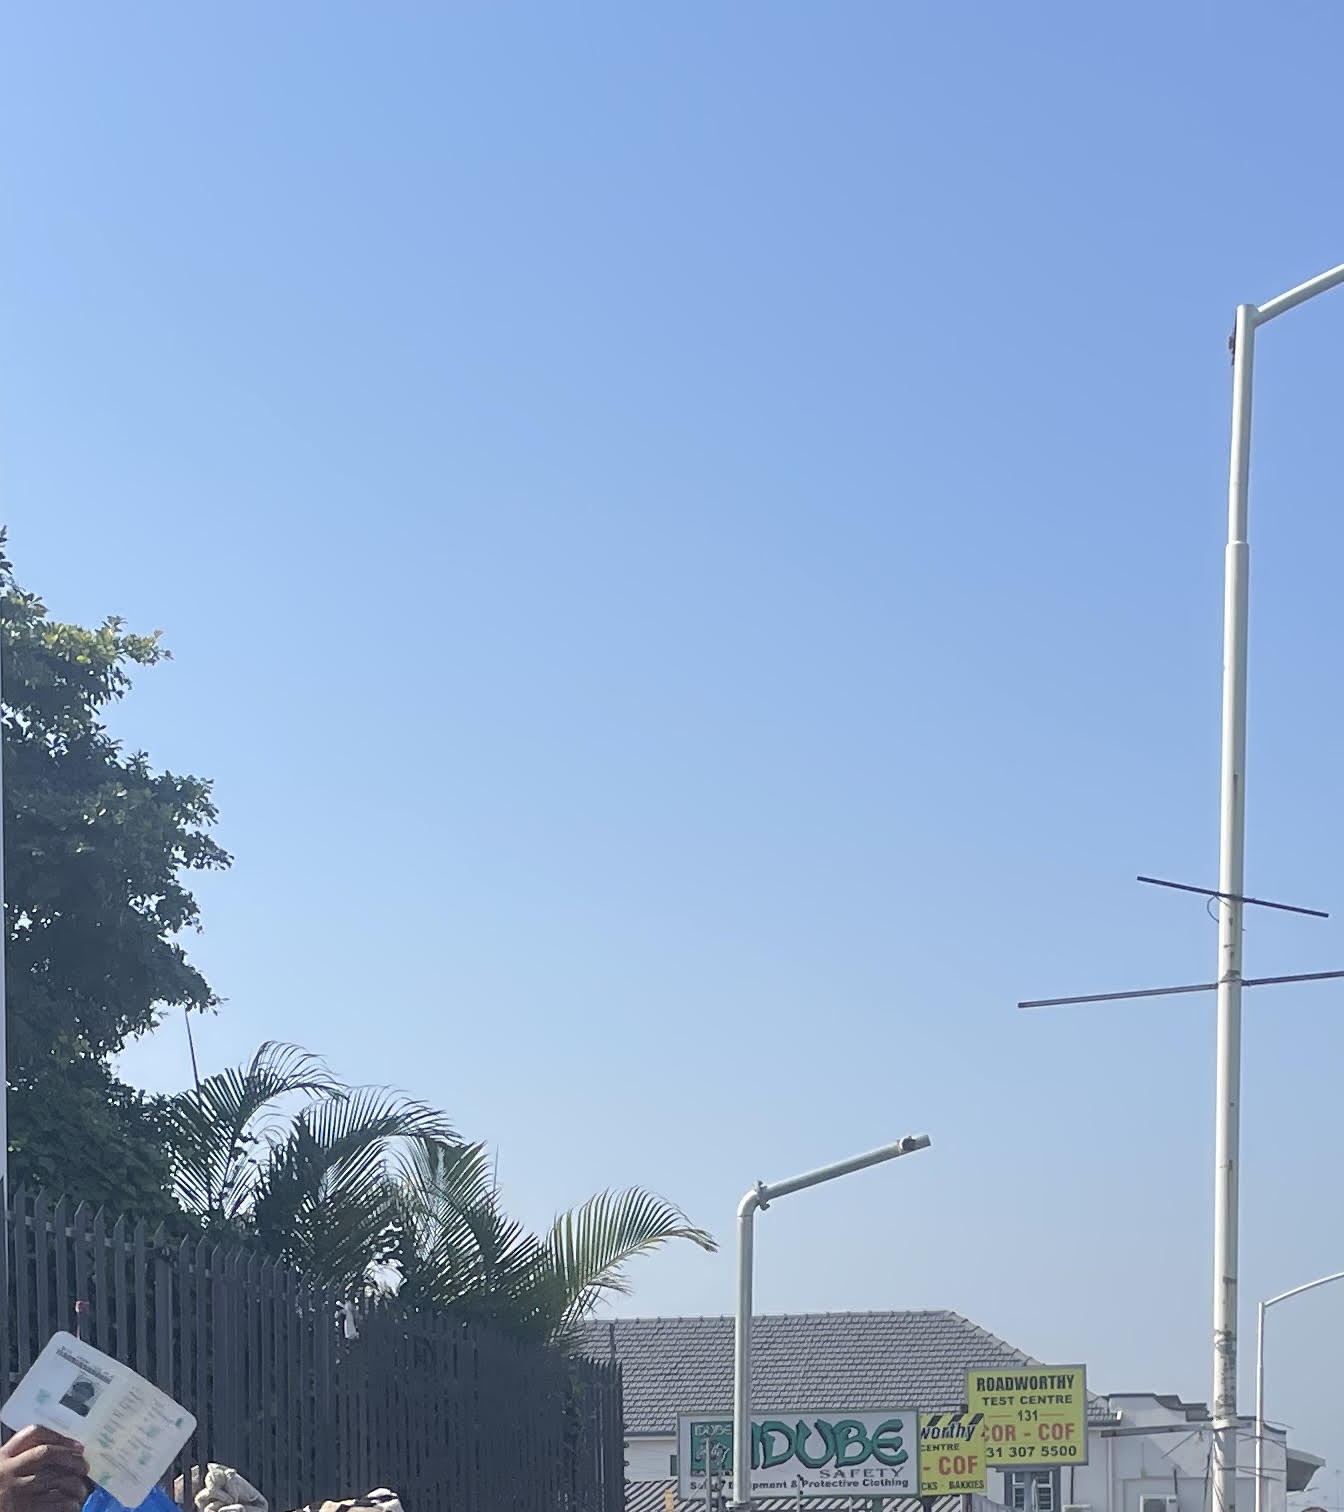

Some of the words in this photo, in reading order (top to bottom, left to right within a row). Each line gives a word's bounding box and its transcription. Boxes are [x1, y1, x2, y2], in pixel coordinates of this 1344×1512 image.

[976, 1374, 1075, 1392] ROADWORTHY
[983, 1396, 1015, 1406] TEST
[1019, 1395, 1073, 1405] CENTRE
[1017, 1410, 1038, 1421] 131
[1038, 1423, 1075, 1441] COF
[1008, 1446, 1035, 1458] 307
[1040, 1445, 1077, 1457] 5500
[938, 1455, 979, 1476] COF
[819, 1467, 904, 1479] SAFETY
[862, 1478, 909, 1488] Clothing
[949, 1479, 984, 1490] BAKKIES
